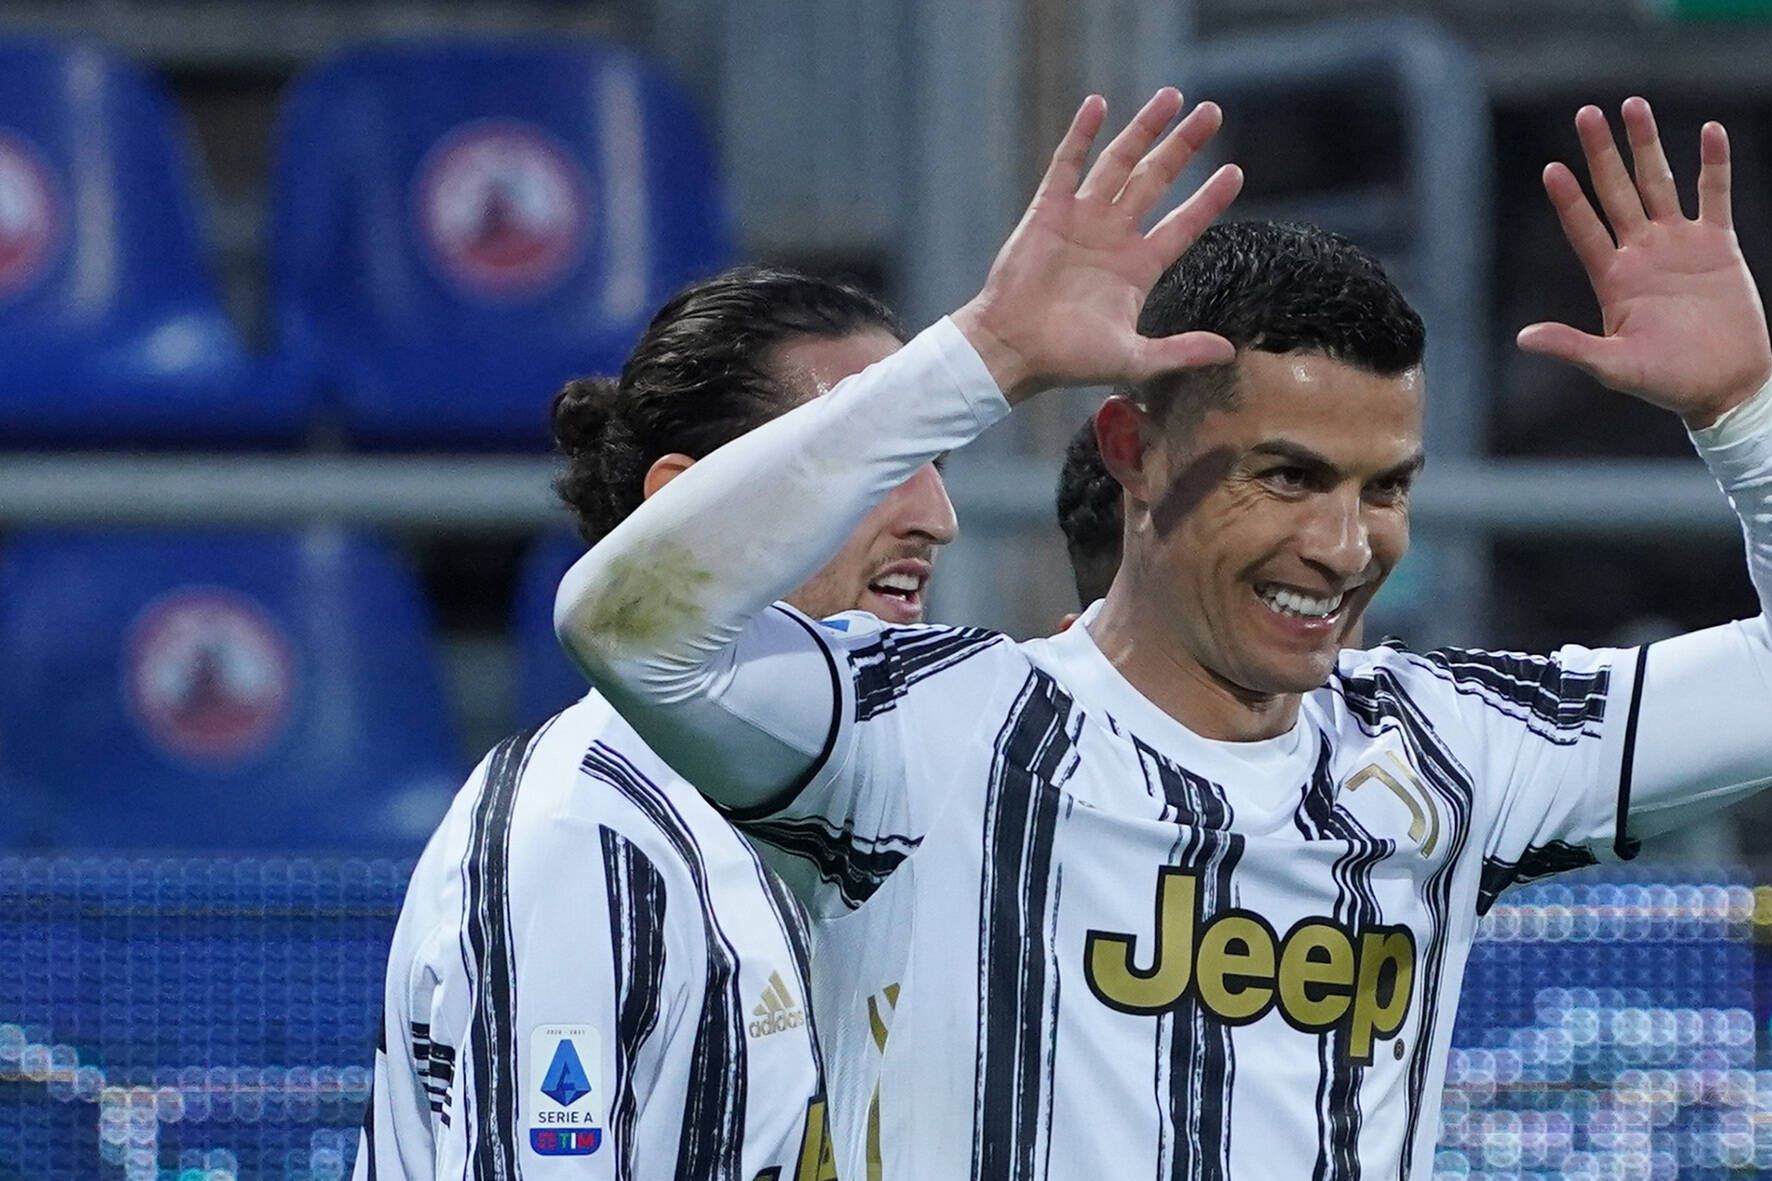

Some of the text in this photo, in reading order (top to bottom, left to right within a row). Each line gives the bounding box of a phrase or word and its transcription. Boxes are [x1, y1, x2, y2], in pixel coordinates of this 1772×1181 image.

[1083, 864, 1417, 1067] Jeep
[538, 1111, 593, 1124] SERIE A
